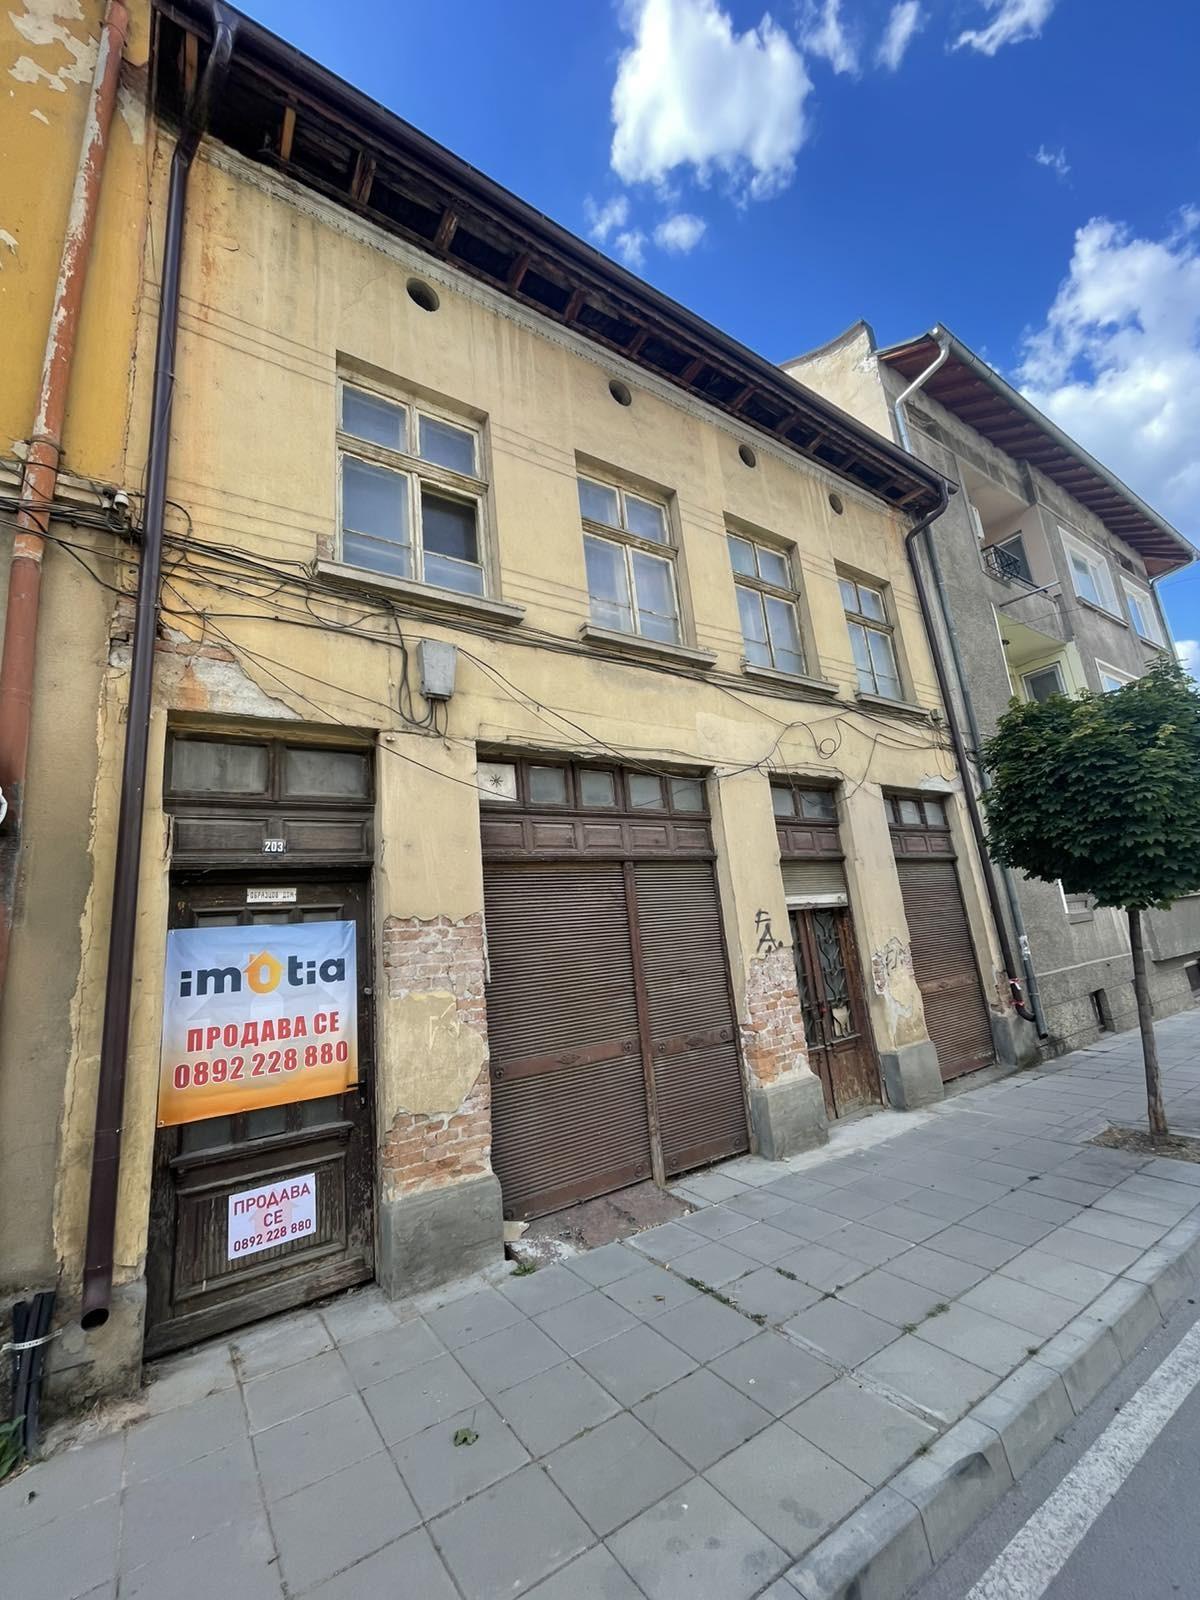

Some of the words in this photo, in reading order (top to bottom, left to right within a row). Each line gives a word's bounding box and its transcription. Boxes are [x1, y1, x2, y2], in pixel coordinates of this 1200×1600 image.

[265, 841, 284, 852] 203
[180, 951, 346, 998] imotia
[187, 1015, 308, 1053] ПРОДАВА
[313, 1011, 340, 1035] СЕ
[174, 1055, 245, 1089] 0892
[251, 1048, 298, 1077] 228
[304, 1040, 349, 1068] 880
[234, 1183, 311, 1216] ПРОДАВА
[233, 1233, 263, 1252] 0892
[266, 1226, 287, 1242] 228
[290, 1218, 312, 1234] 880
[263, 1209, 284, 1228] СЕ
